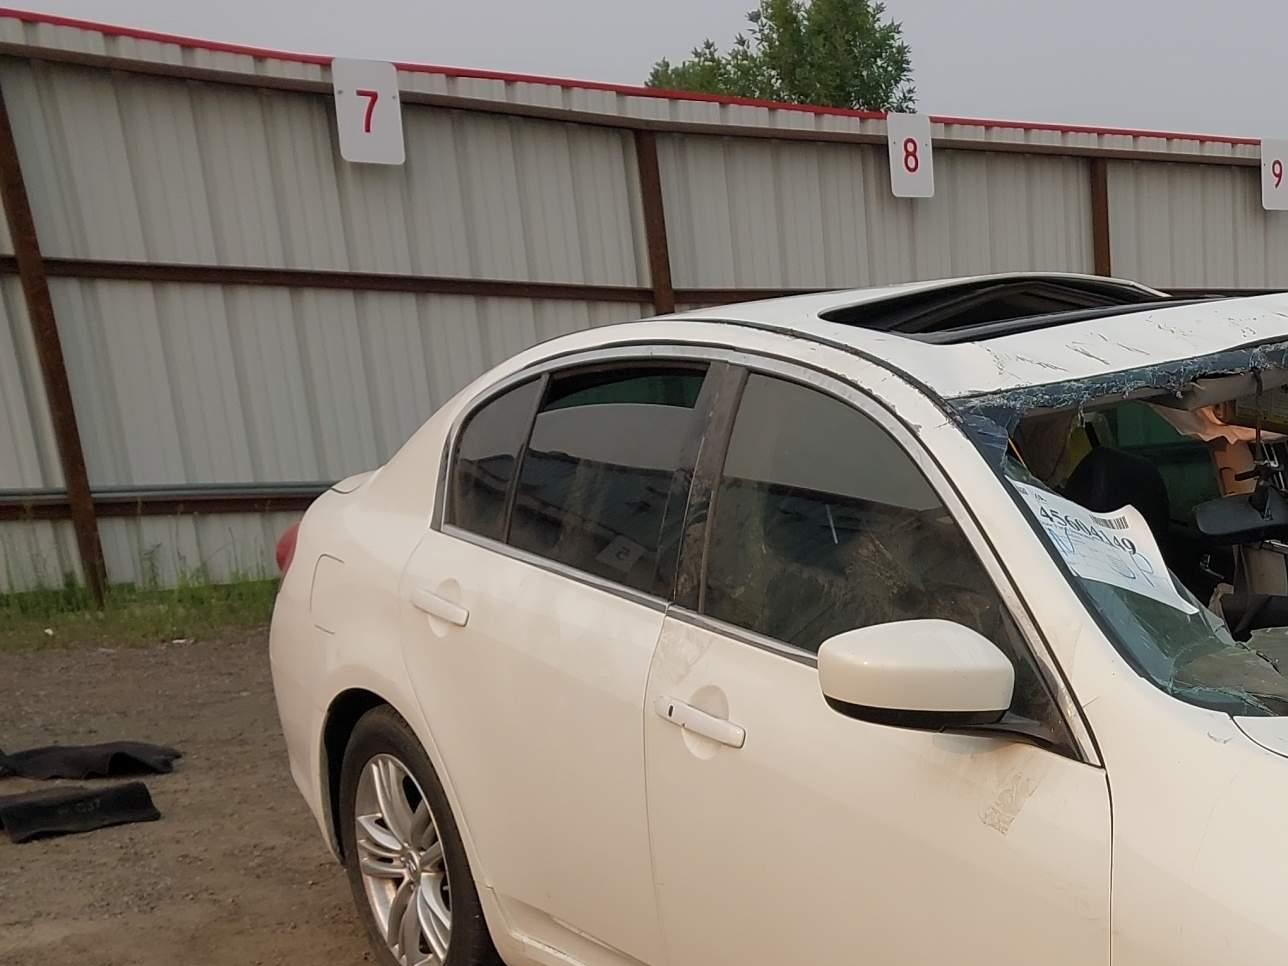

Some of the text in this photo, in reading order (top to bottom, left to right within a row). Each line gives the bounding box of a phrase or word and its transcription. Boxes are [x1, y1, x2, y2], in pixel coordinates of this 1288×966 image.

[355, 89, 379, 133] 7
[903, 137, 919, 173] 8
[1271, 159, 1285, 187] 9
[1039, 505, 1137, 555] 45604149
